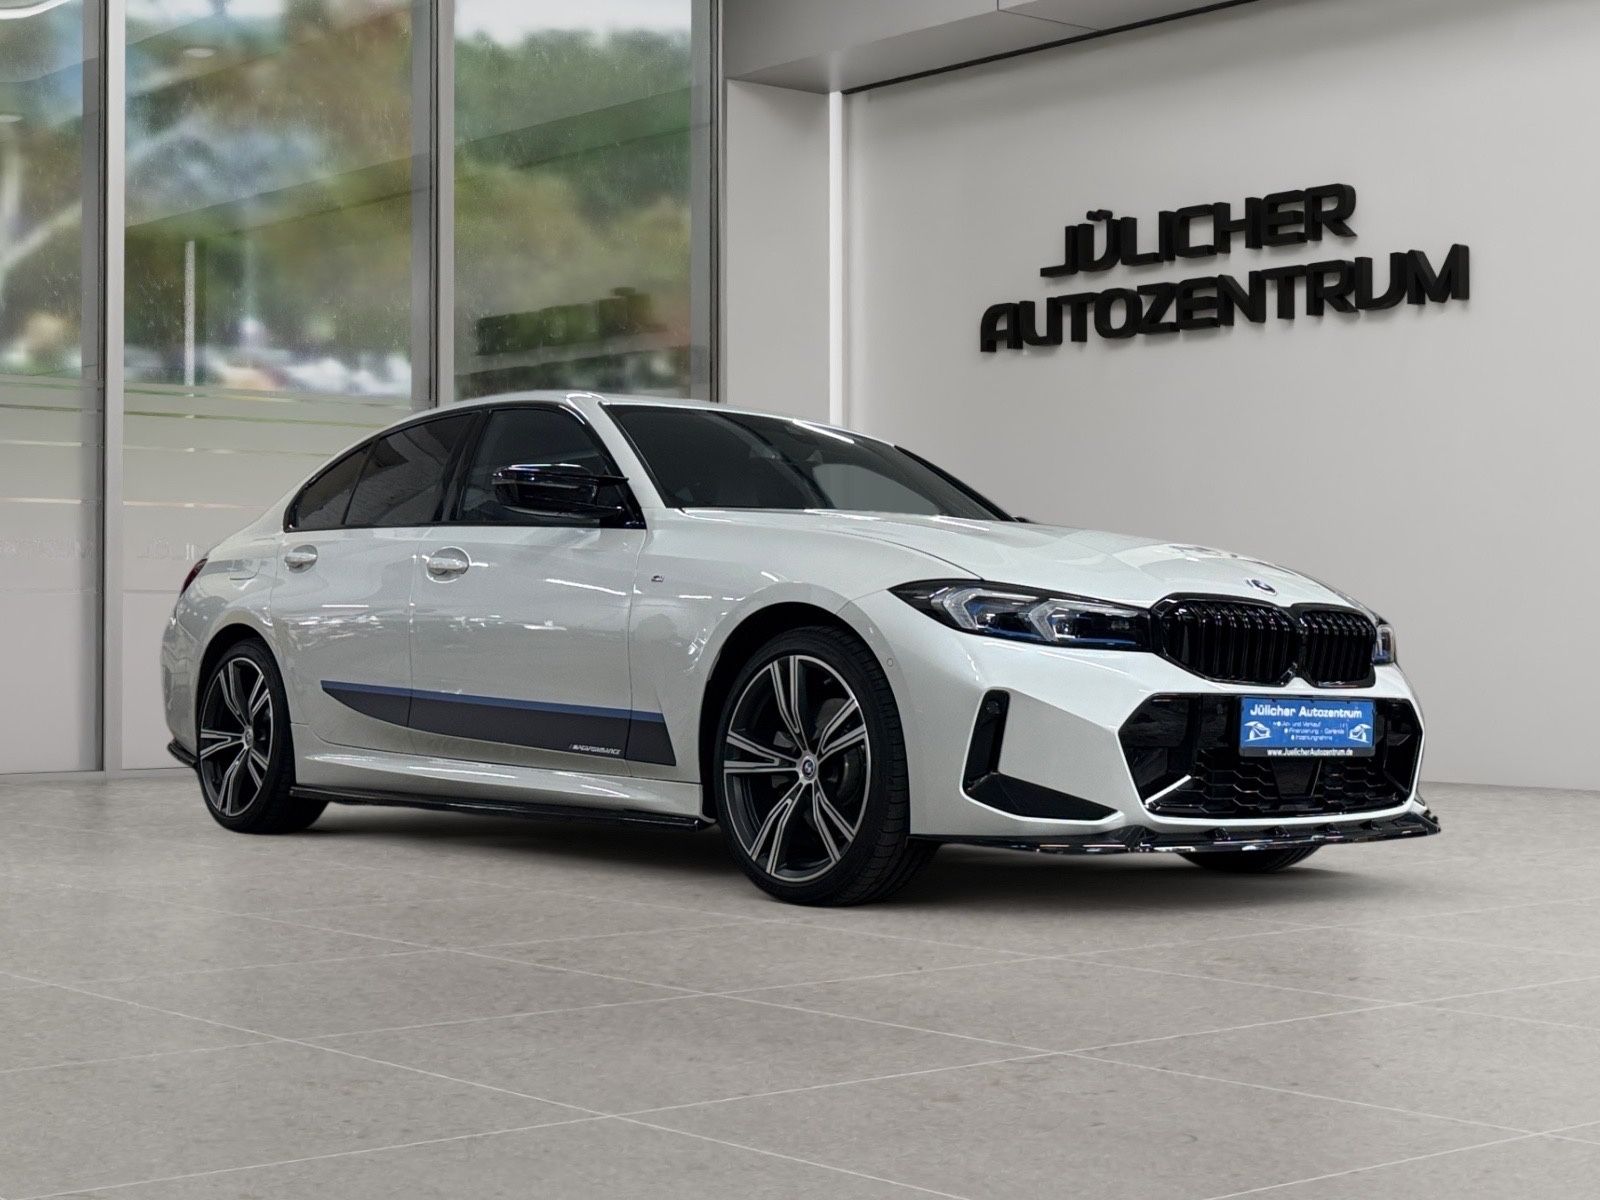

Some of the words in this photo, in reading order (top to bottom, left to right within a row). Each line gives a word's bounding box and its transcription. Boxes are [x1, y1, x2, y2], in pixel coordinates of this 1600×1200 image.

[1040, 183, 1357, 278] JÜLICHER
[980, 244, 1470, 352] AUTOZENTRUM
[1250, 704, 1296, 717] Jülicher
[1298, 706, 1362, 718] Autozentrum
